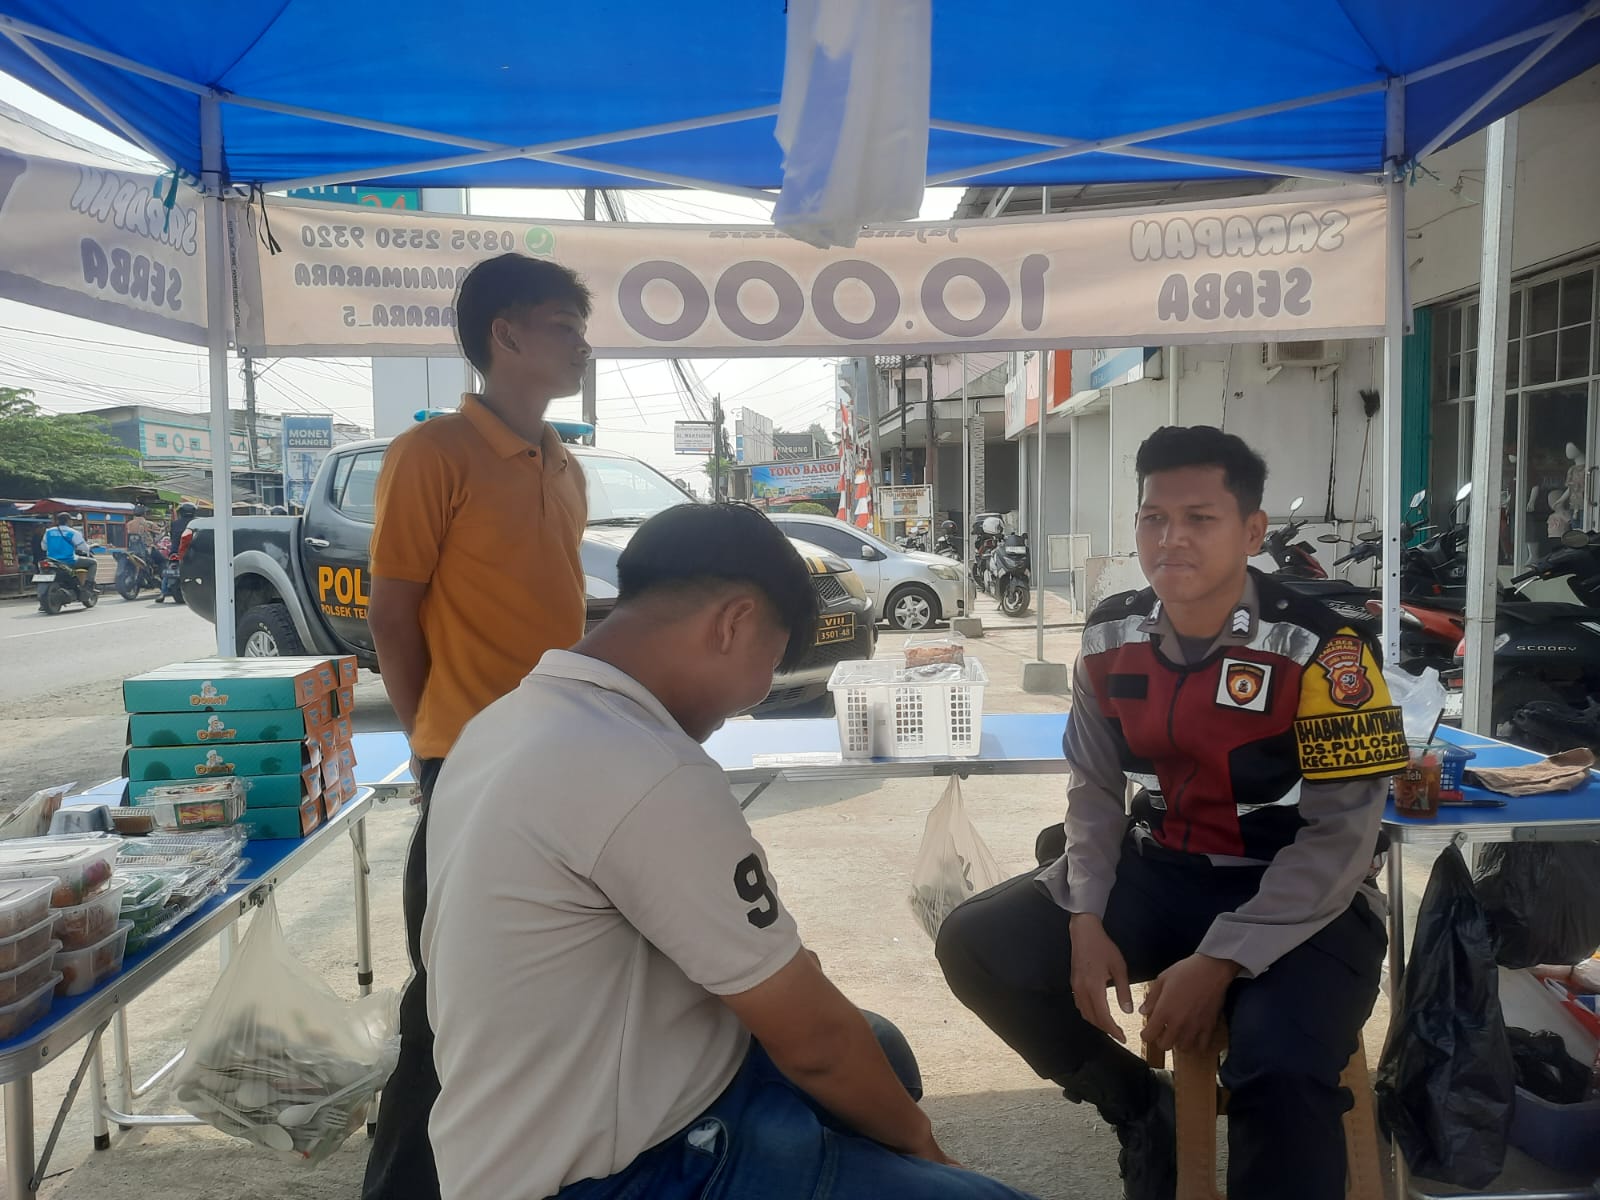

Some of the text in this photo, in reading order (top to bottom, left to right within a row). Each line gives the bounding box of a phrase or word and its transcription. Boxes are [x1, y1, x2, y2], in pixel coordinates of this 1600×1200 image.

[289, 429, 329, 438] MONEY
[288, 438, 329, 446] CHANGER
[769, 465, 800, 477] TOKO
[318, 566, 369, 606] POL
[320, 604, 369, 620] POLSEK TEL
[825, 617, 845, 626] VIII
[734, 853, 779, 929] 9
